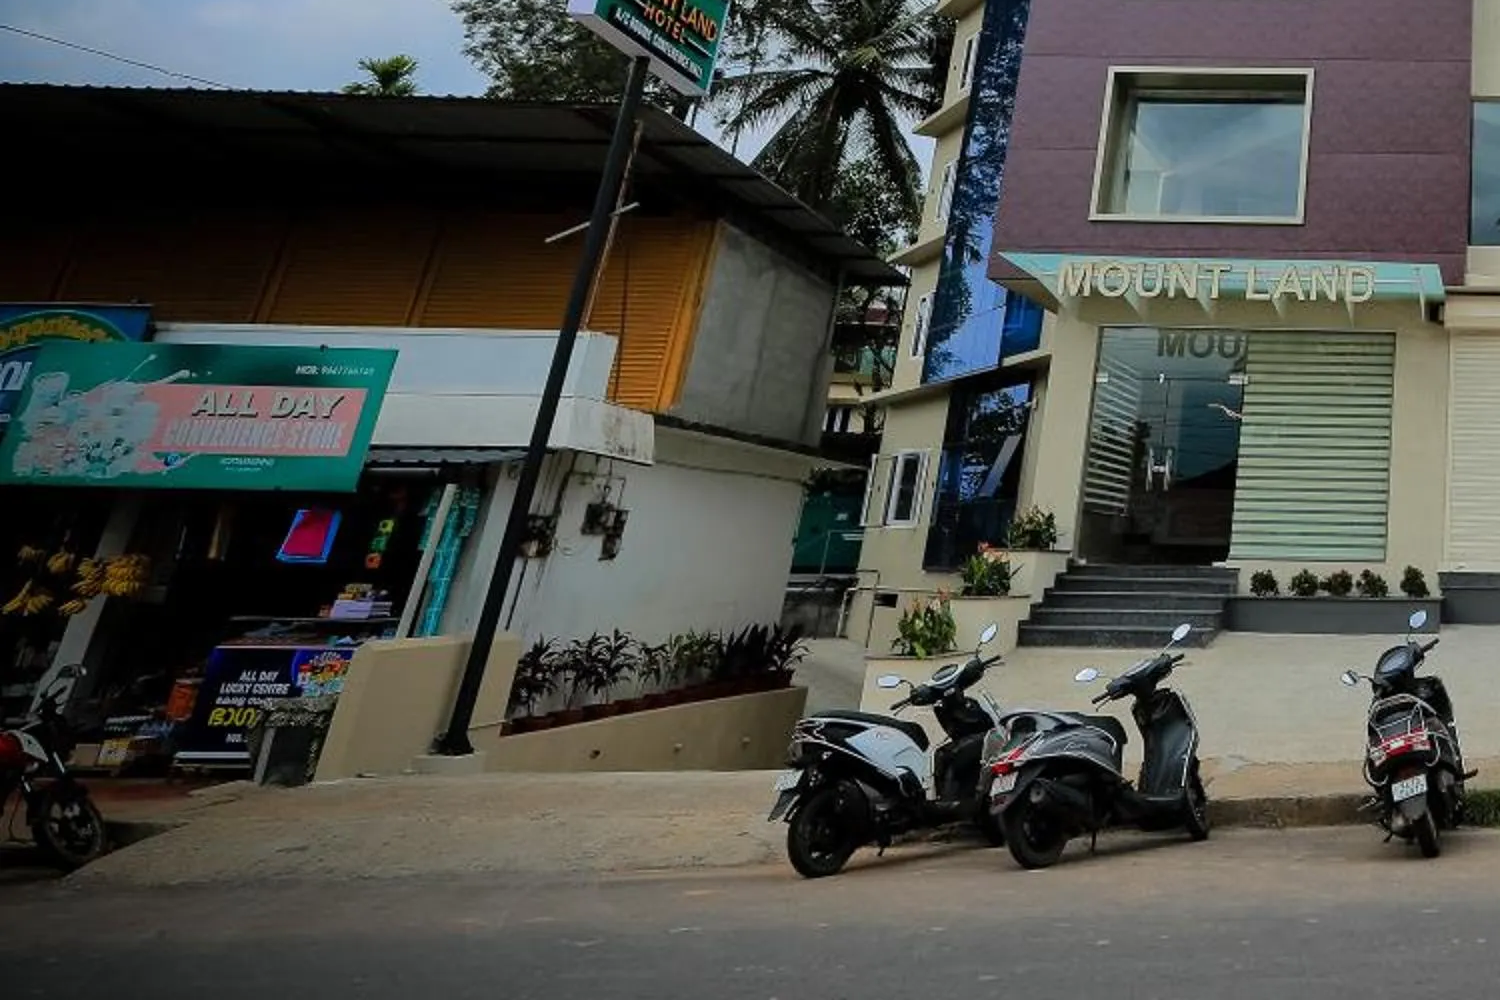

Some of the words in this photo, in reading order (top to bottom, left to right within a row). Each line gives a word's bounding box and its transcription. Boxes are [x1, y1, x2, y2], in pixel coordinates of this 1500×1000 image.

[643, 1, 686, 44] HOTEL
[1057, 261, 1232, 299] MOUNT
[1245, 265, 1377, 303] LAND
[192, 390, 259, 417] ALL
[271, 391, 345, 419] DAY
[163, 418, 284, 448] CONVENIENCE
[220, 683, 251, 694] LUCKY
[252, 683, 291, 695] CENTRE
[240, 670, 257, 682] ALL
[258, 671, 280, 682] DAY
